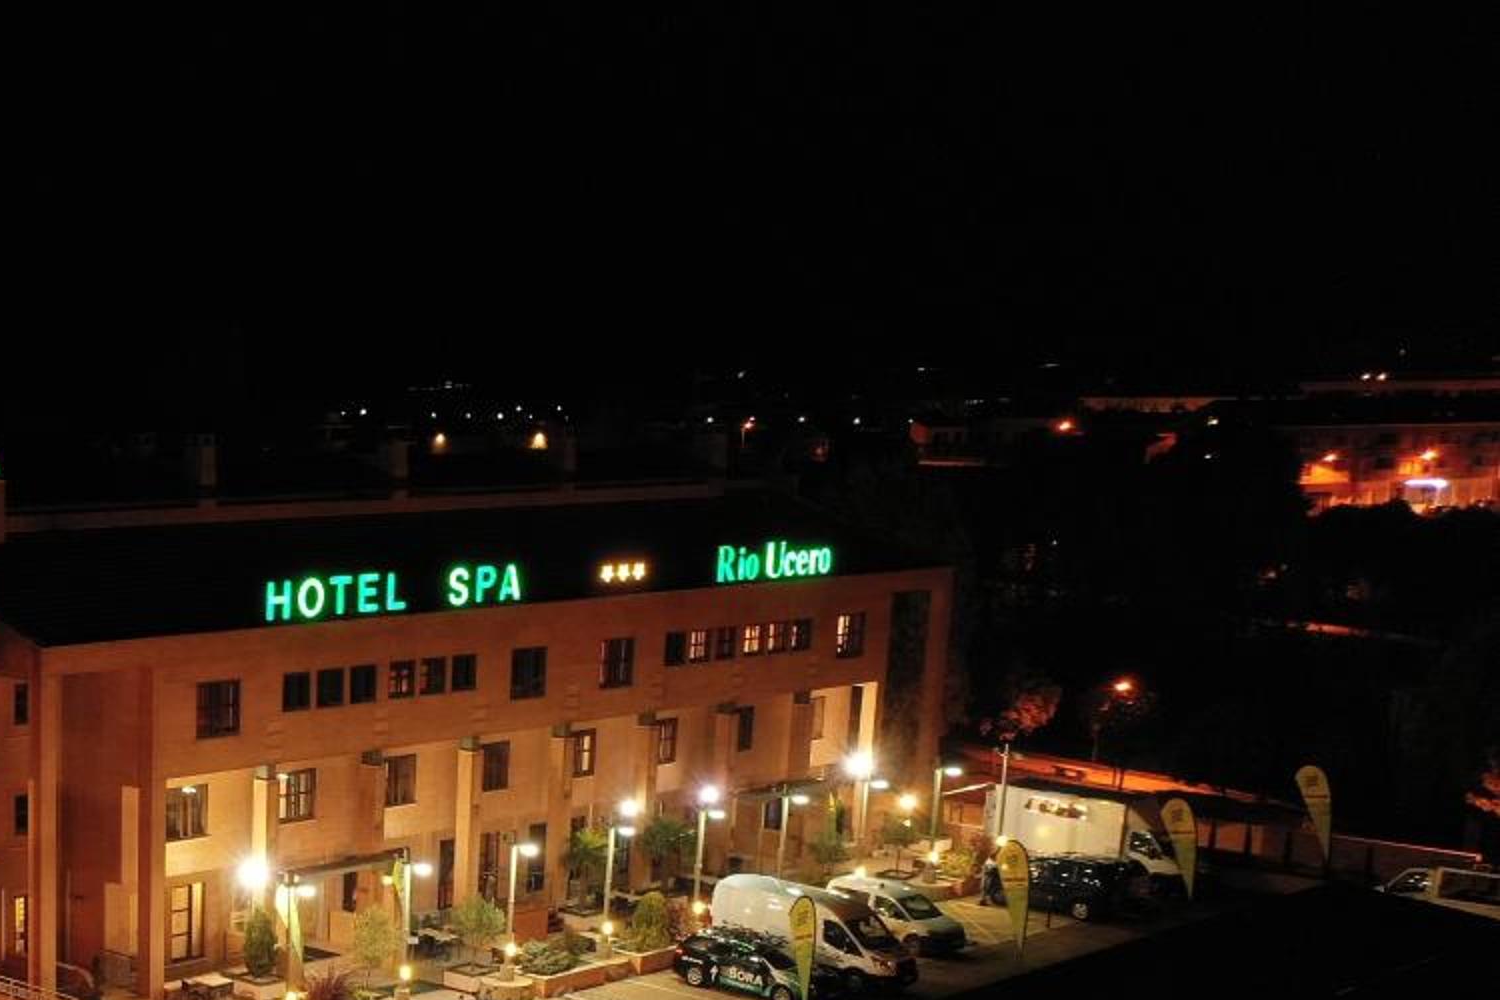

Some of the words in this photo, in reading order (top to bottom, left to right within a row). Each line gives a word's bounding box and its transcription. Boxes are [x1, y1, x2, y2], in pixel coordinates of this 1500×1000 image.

[765, 541, 832, 579] Ucero
[264, 571, 407, 622] HOTEL
[448, 563, 521, 607] SPA
[728, 967, 763, 986] BORA
